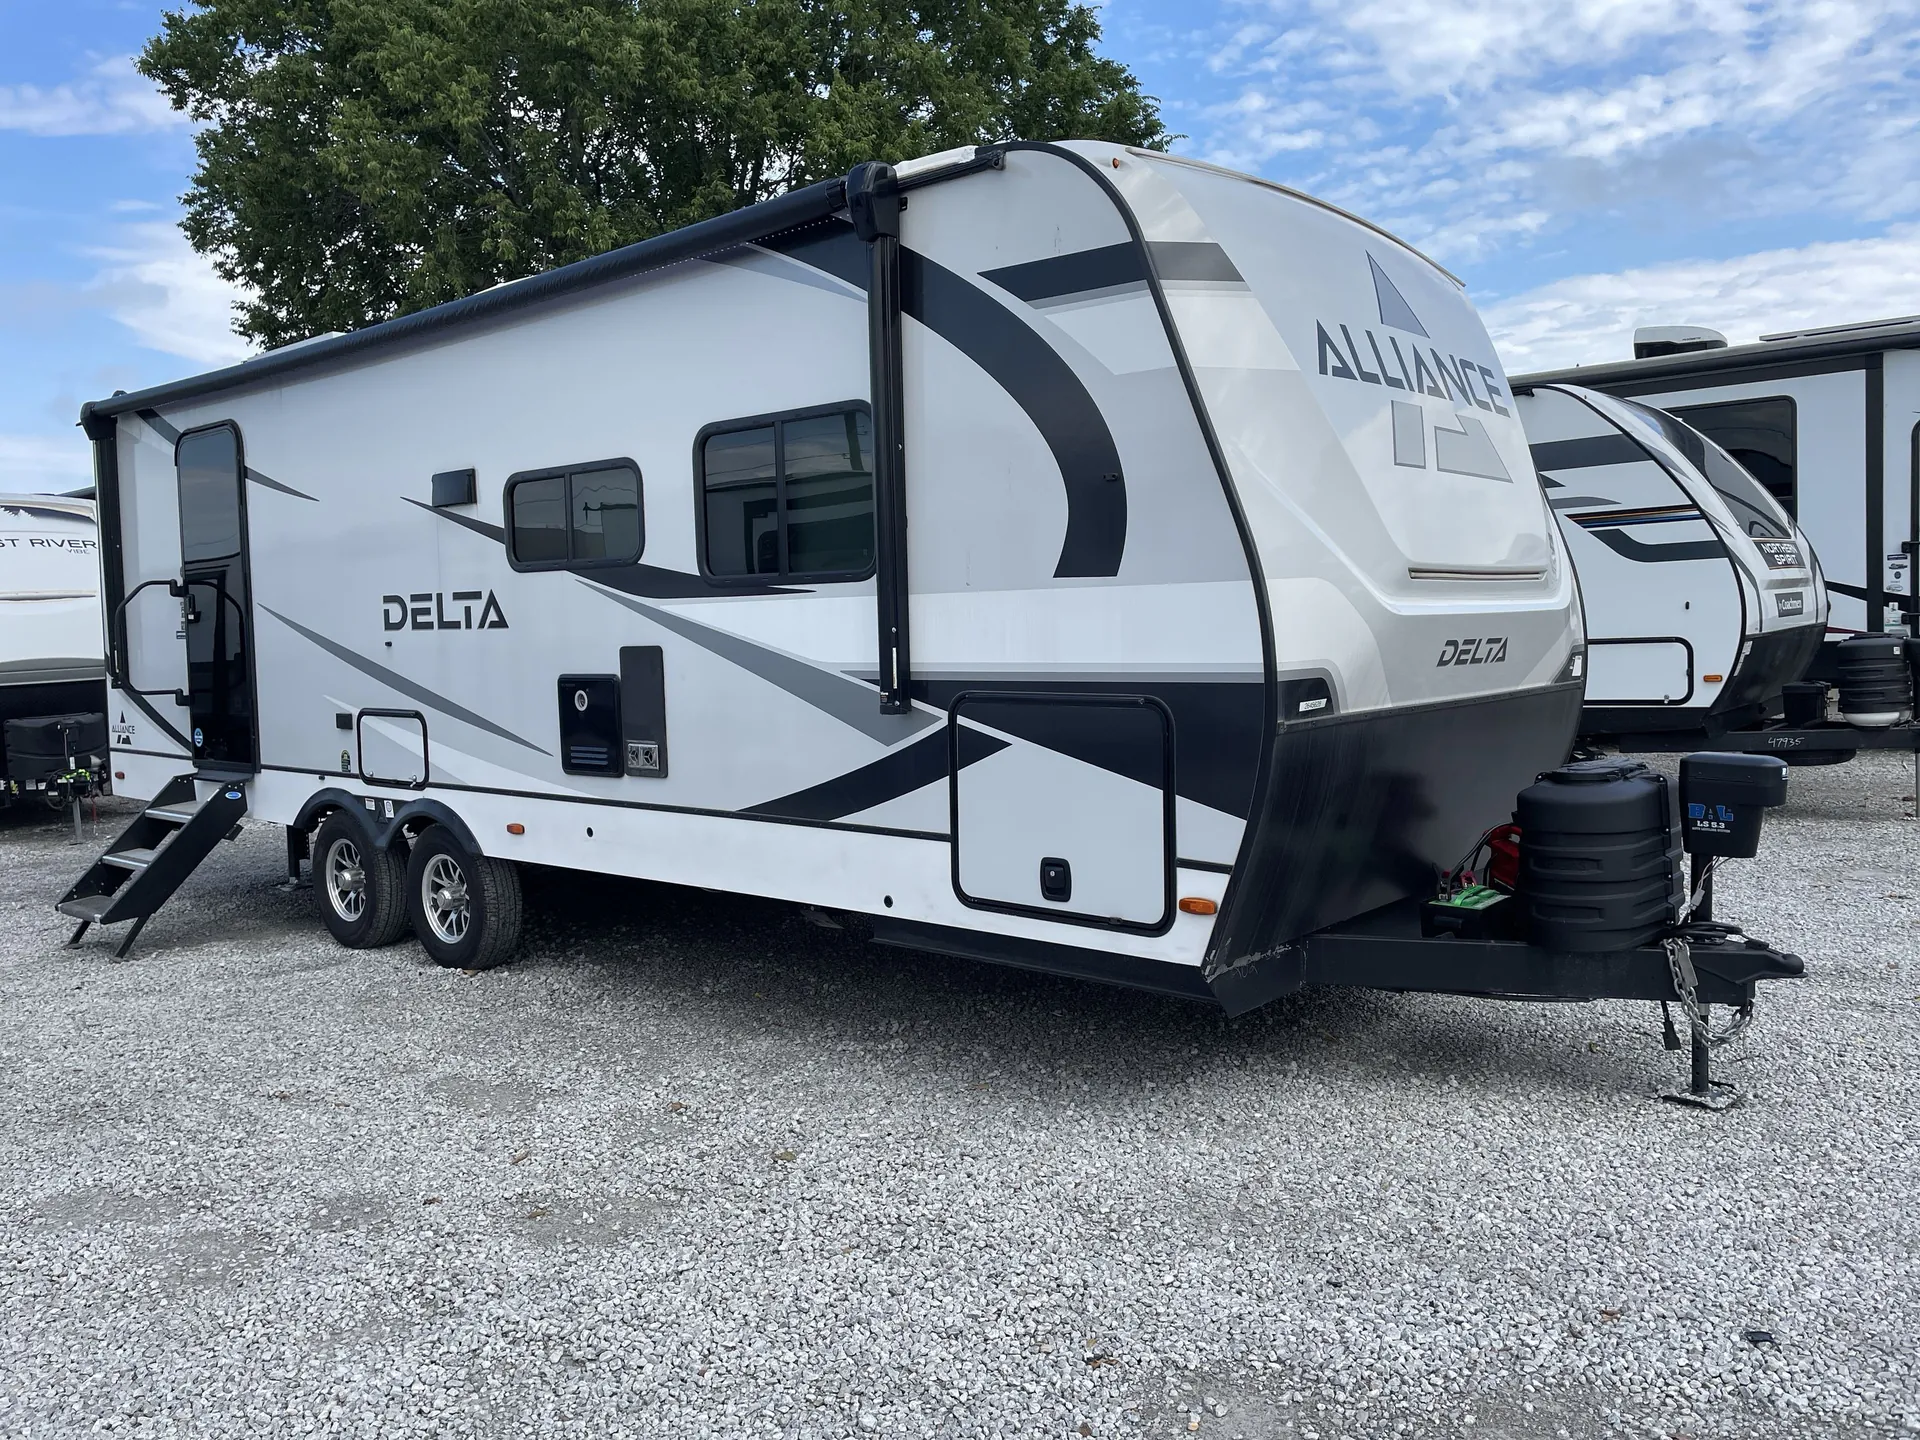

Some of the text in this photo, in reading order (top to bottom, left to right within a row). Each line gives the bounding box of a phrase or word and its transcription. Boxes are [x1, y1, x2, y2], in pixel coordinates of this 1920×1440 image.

[1316, 319, 1511, 418] ALLIANCE
[29, 538, 97, 549] RIVER
[1760, 543, 1798, 554] NORTHERN
[1774, 554, 1798, 565] SPIRIT
[382, 588, 510, 631] DELTA
[1782, 598, 1802, 610] Coachmen
[1436, 636, 1509, 668] DELTA
[111, 725, 136, 735] ALLIANCE
[1767, 737, 1806, 748] 47935
[1696, 820, 1710, 828] LS
